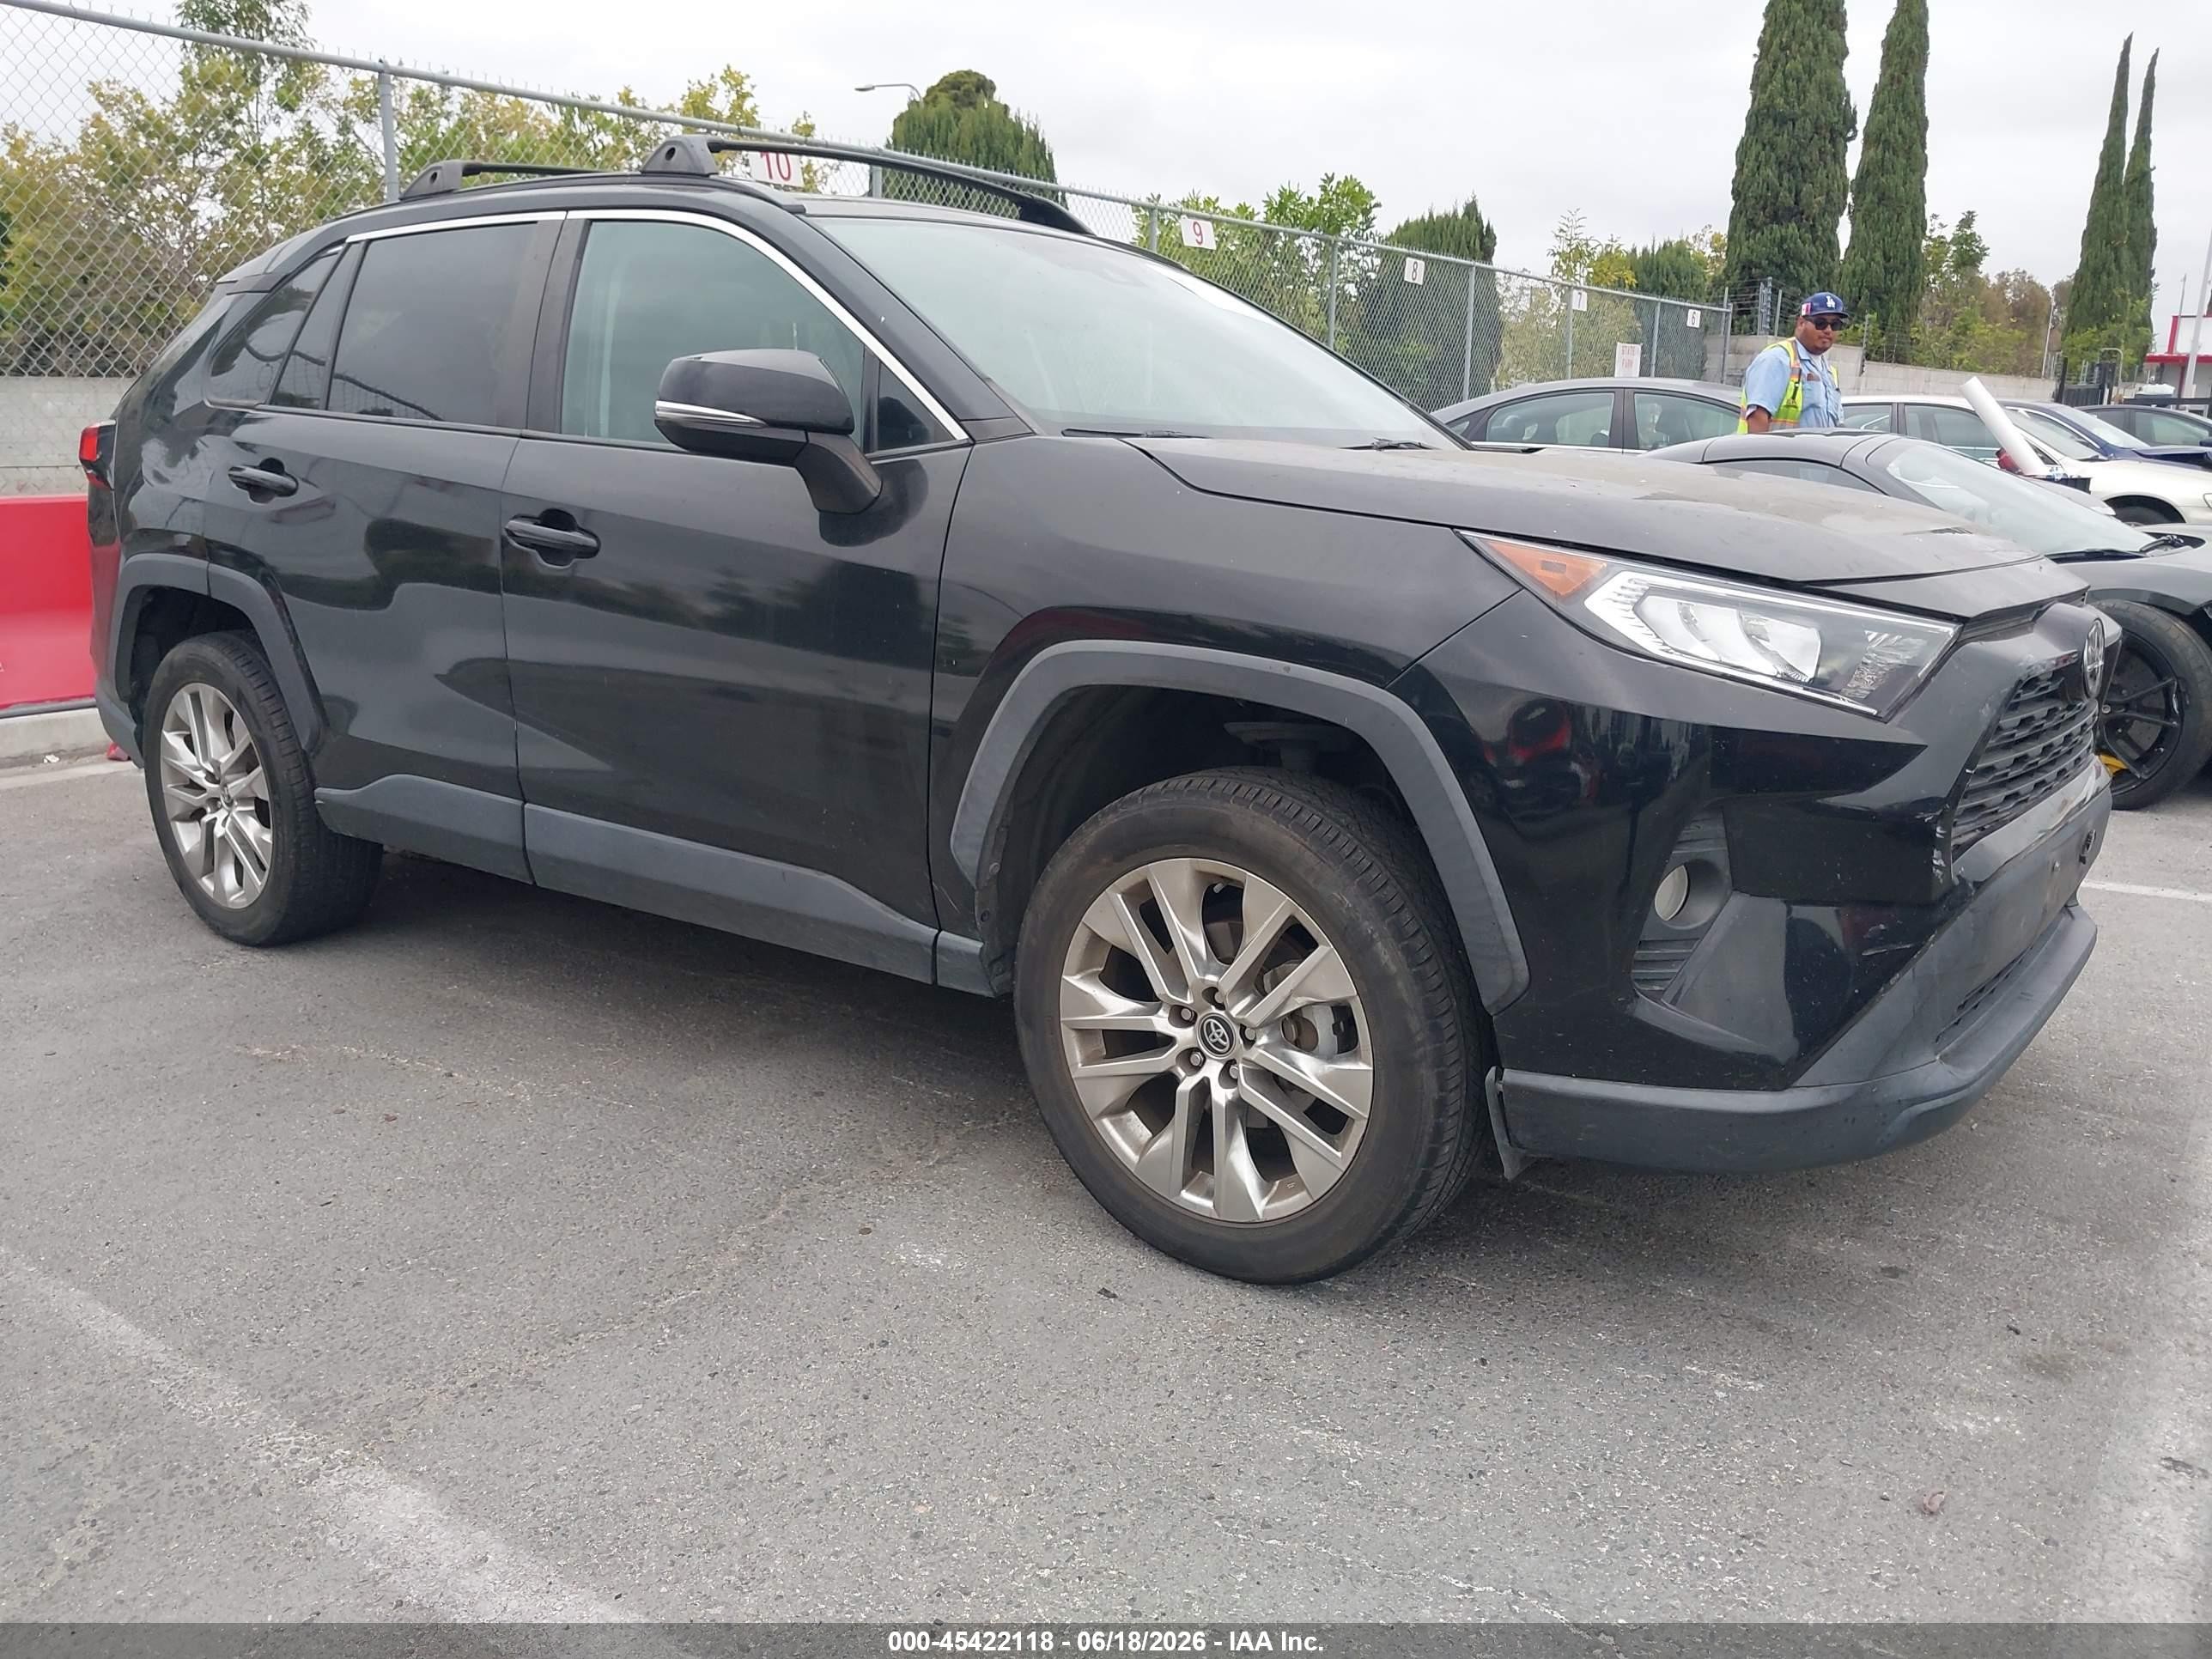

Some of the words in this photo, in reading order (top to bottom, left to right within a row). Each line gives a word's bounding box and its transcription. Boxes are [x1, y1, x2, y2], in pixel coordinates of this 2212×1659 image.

[760, 151, 791, 181] 10
[1193, 221, 1204, 245] 9
[1411, 261, 1419, 281] 8
[1577, 292, 1583, 309] 7
[1826, 295, 1836, 308] LA
[1691, 311, 1696, 325] 6
